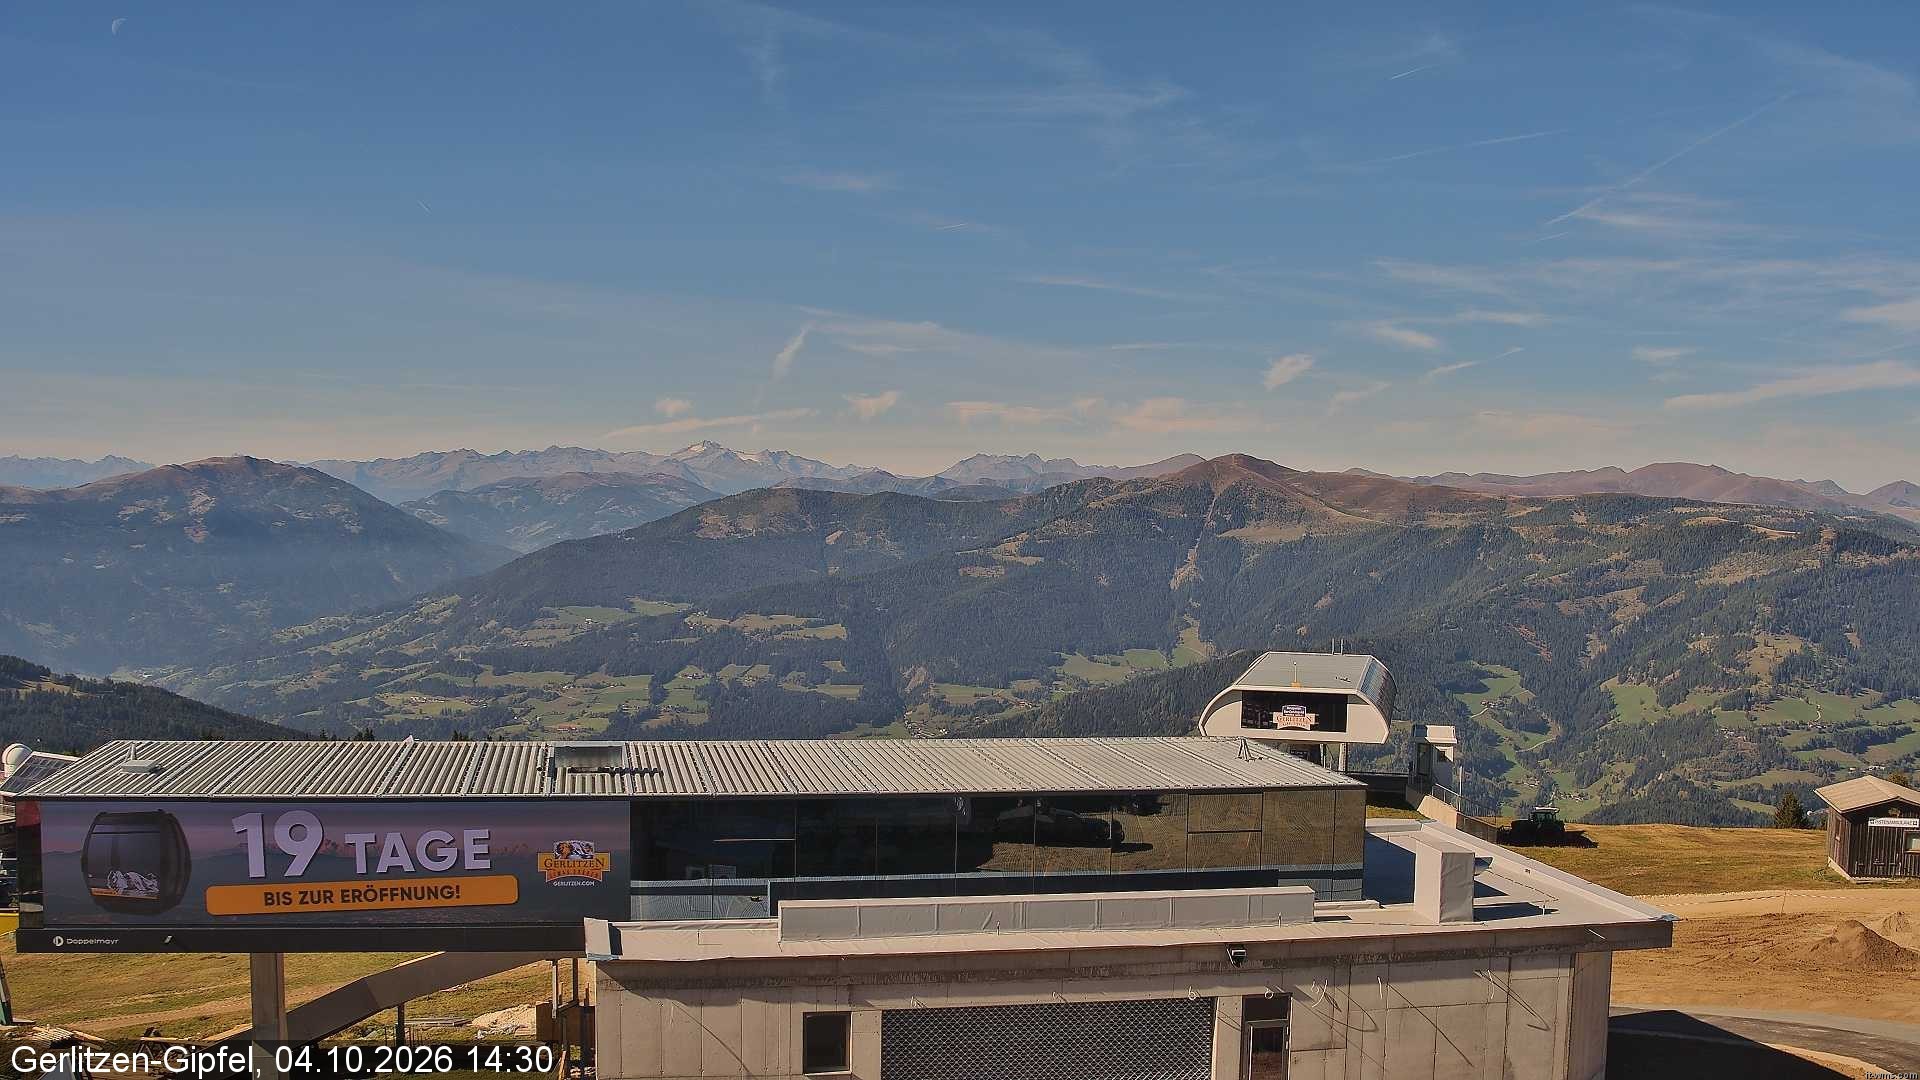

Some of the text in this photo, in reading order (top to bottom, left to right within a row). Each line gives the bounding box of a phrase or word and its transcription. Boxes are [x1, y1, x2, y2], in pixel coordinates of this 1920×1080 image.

[232, 810, 491, 879] 19 TAGE
[544, 858, 604, 868] GERLITZEN
[263, 885, 461, 906] BIS ZUR ERÖFFNUNG!
[66, 937, 119, 945] Doppelmayr
